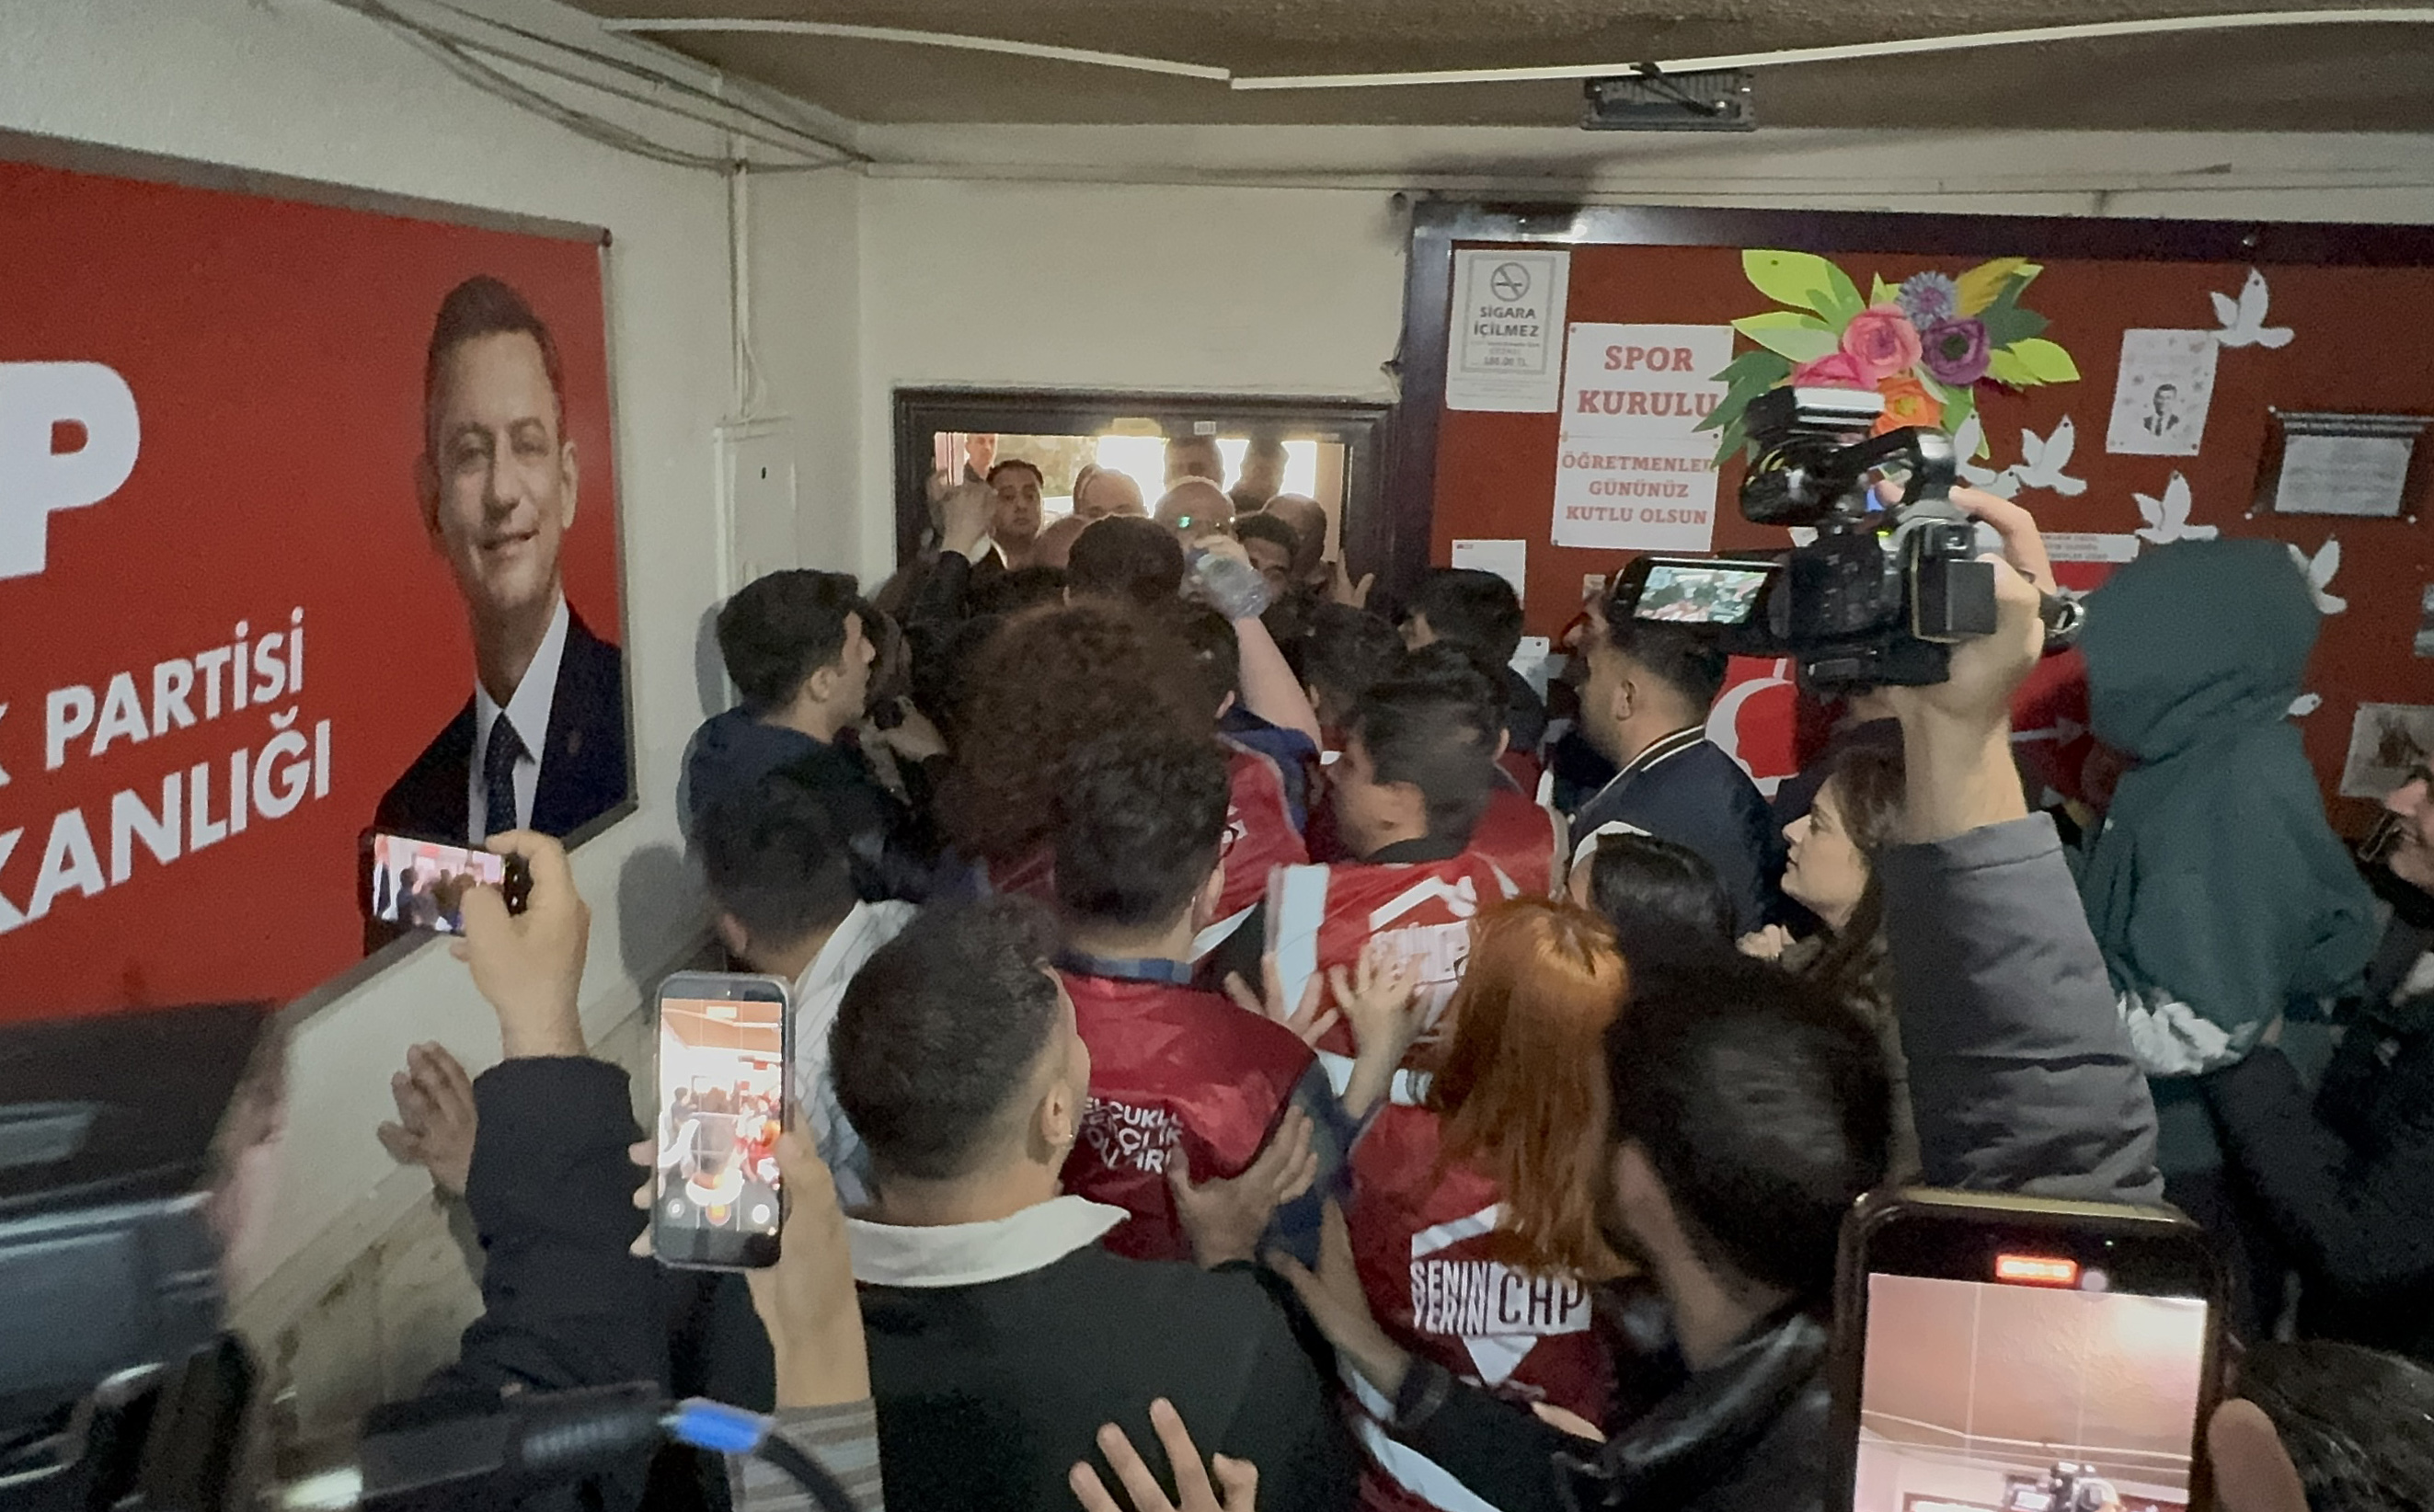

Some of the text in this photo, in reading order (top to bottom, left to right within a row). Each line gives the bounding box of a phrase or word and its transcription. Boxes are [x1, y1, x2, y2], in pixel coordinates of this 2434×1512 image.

[1479, 304, 1536, 319] SİGARA
[1474, 321, 1539, 338] İÇİLMEZ
[1604, 345, 1694, 372] SPOR
[1577, 390, 1719, 418] KURULU
[1589, 479, 1690, 498] GÜNÜNÜZ
[1567, 507, 1707, 524] KUTLU OLSUN
[46, 606, 304, 771] PARTİSİ
[1498, 1273, 1586, 1325] CHP
